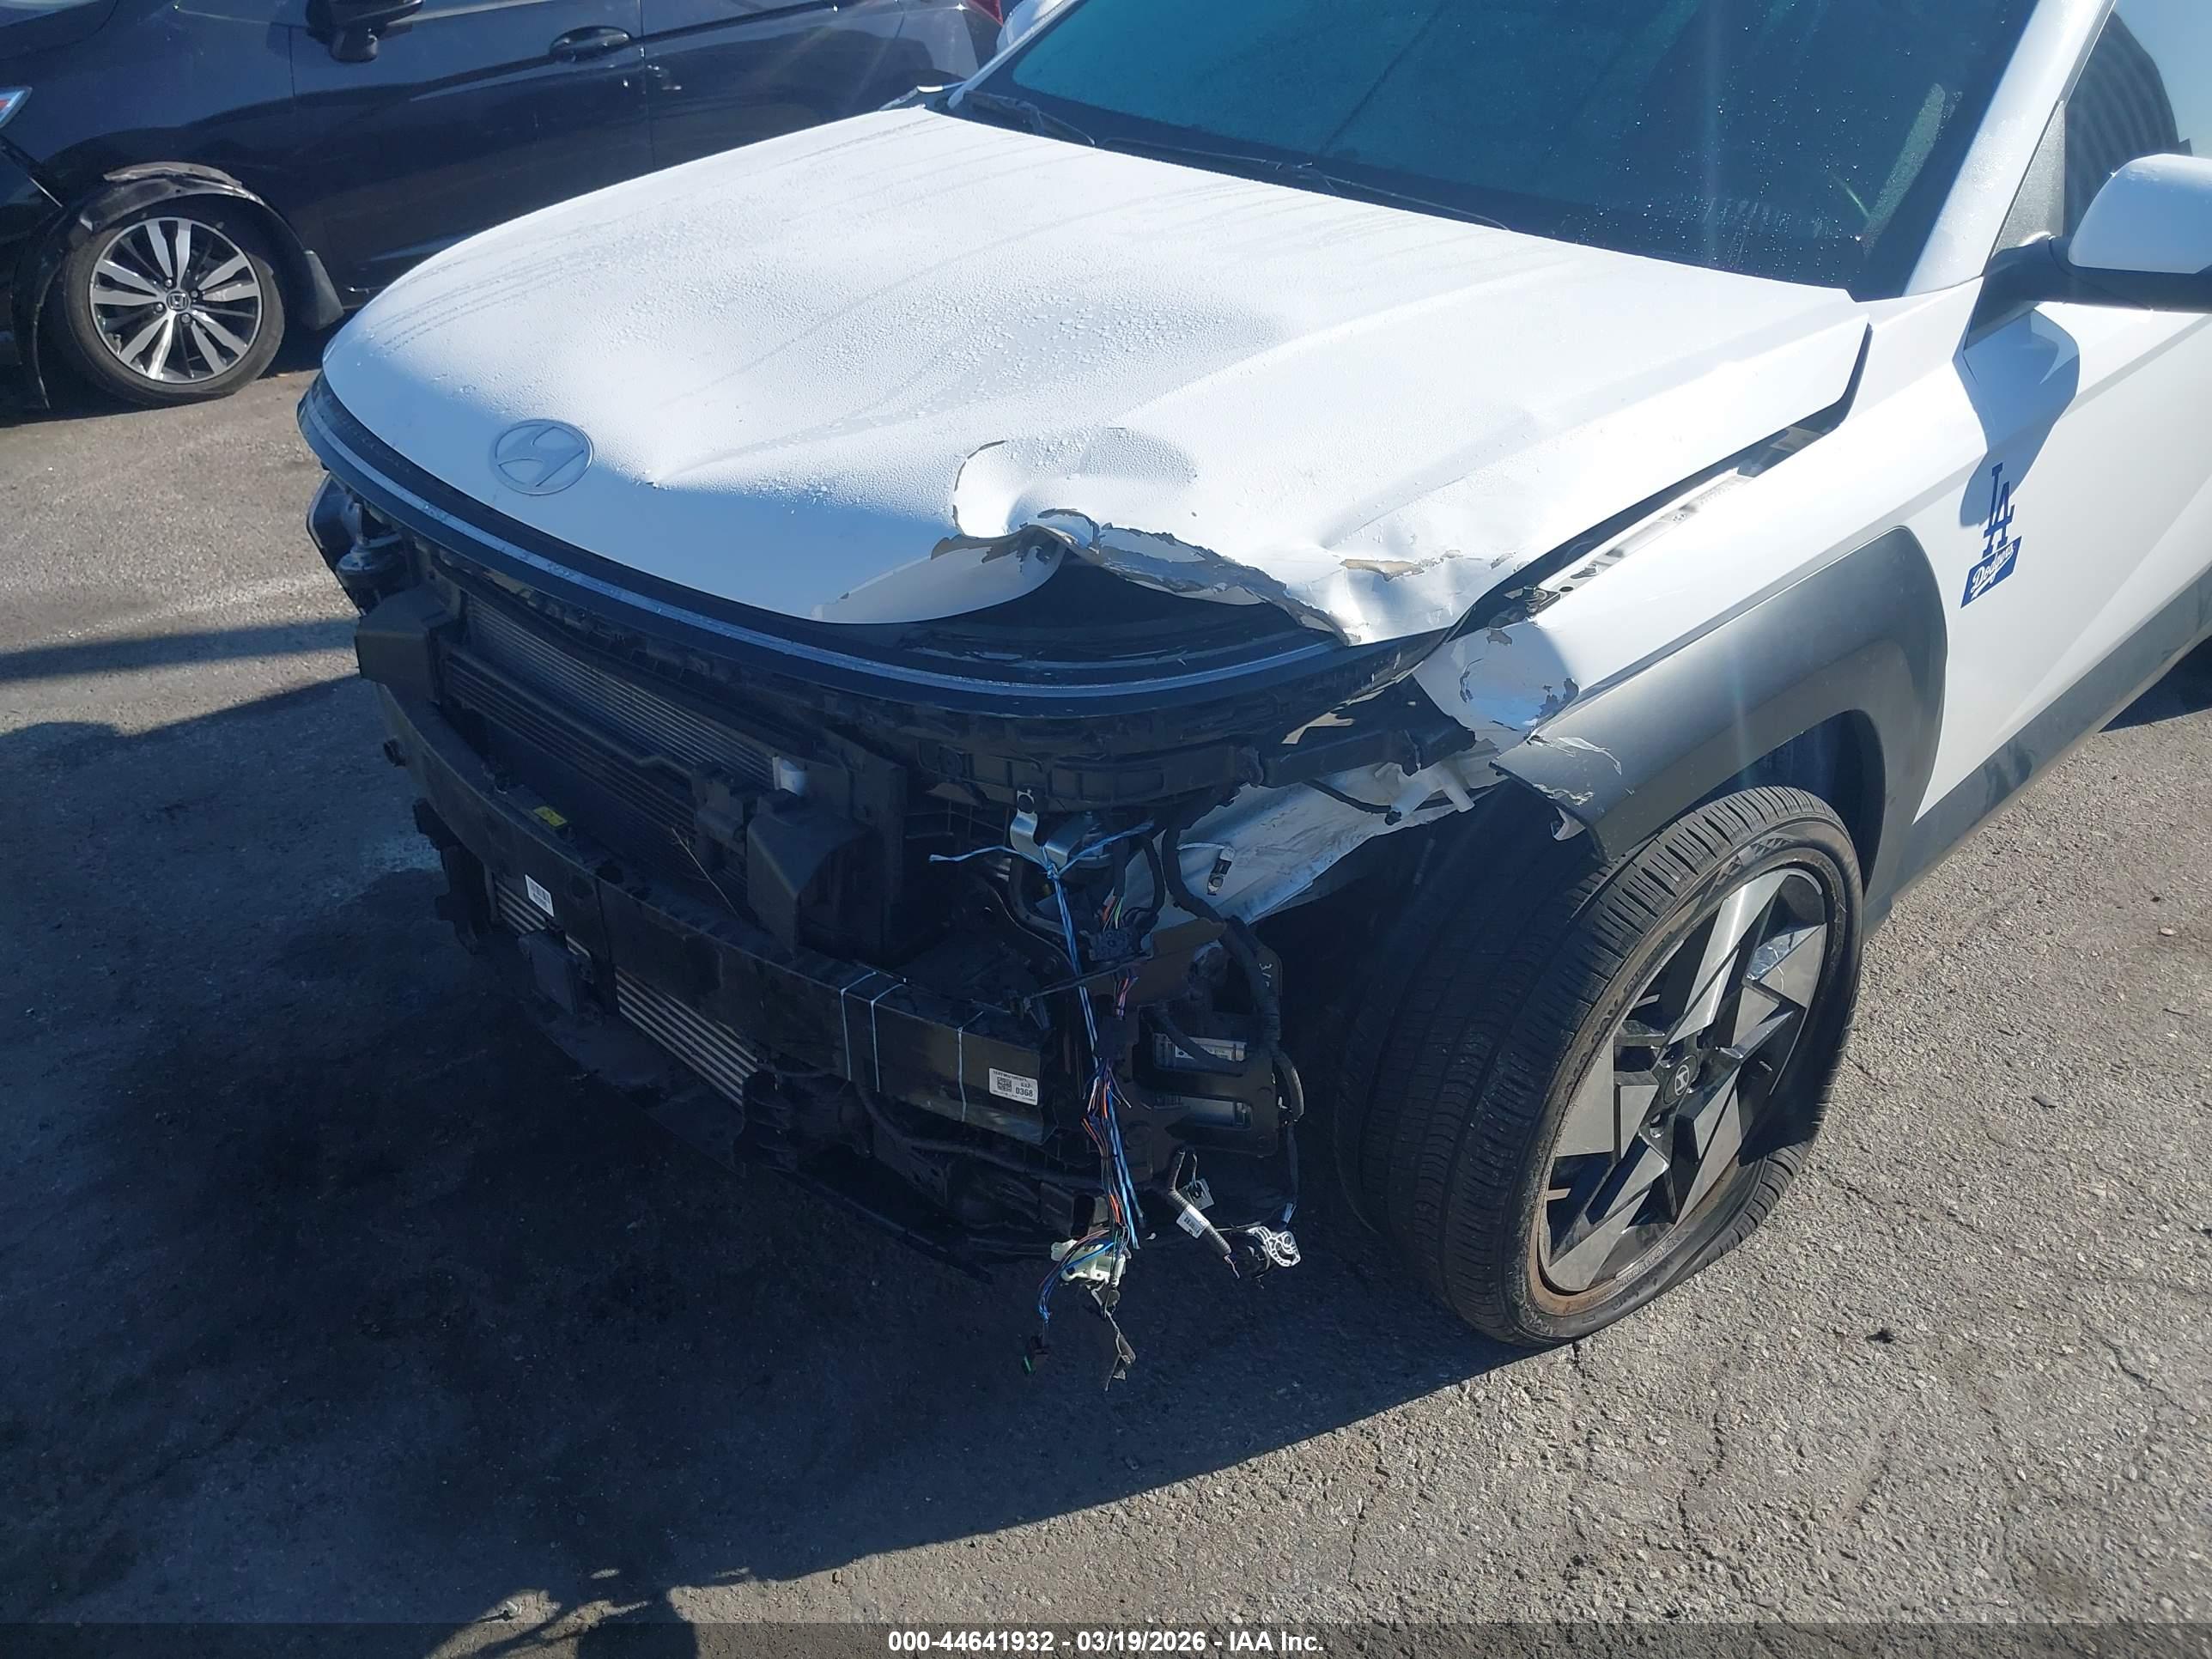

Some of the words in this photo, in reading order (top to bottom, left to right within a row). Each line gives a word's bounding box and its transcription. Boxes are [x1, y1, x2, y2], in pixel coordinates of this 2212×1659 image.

[1982, 462, 2015, 559] LA
[1970, 543, 2014, 599] Dodgers
[1015, 1086, 1034, 1097] 0368
